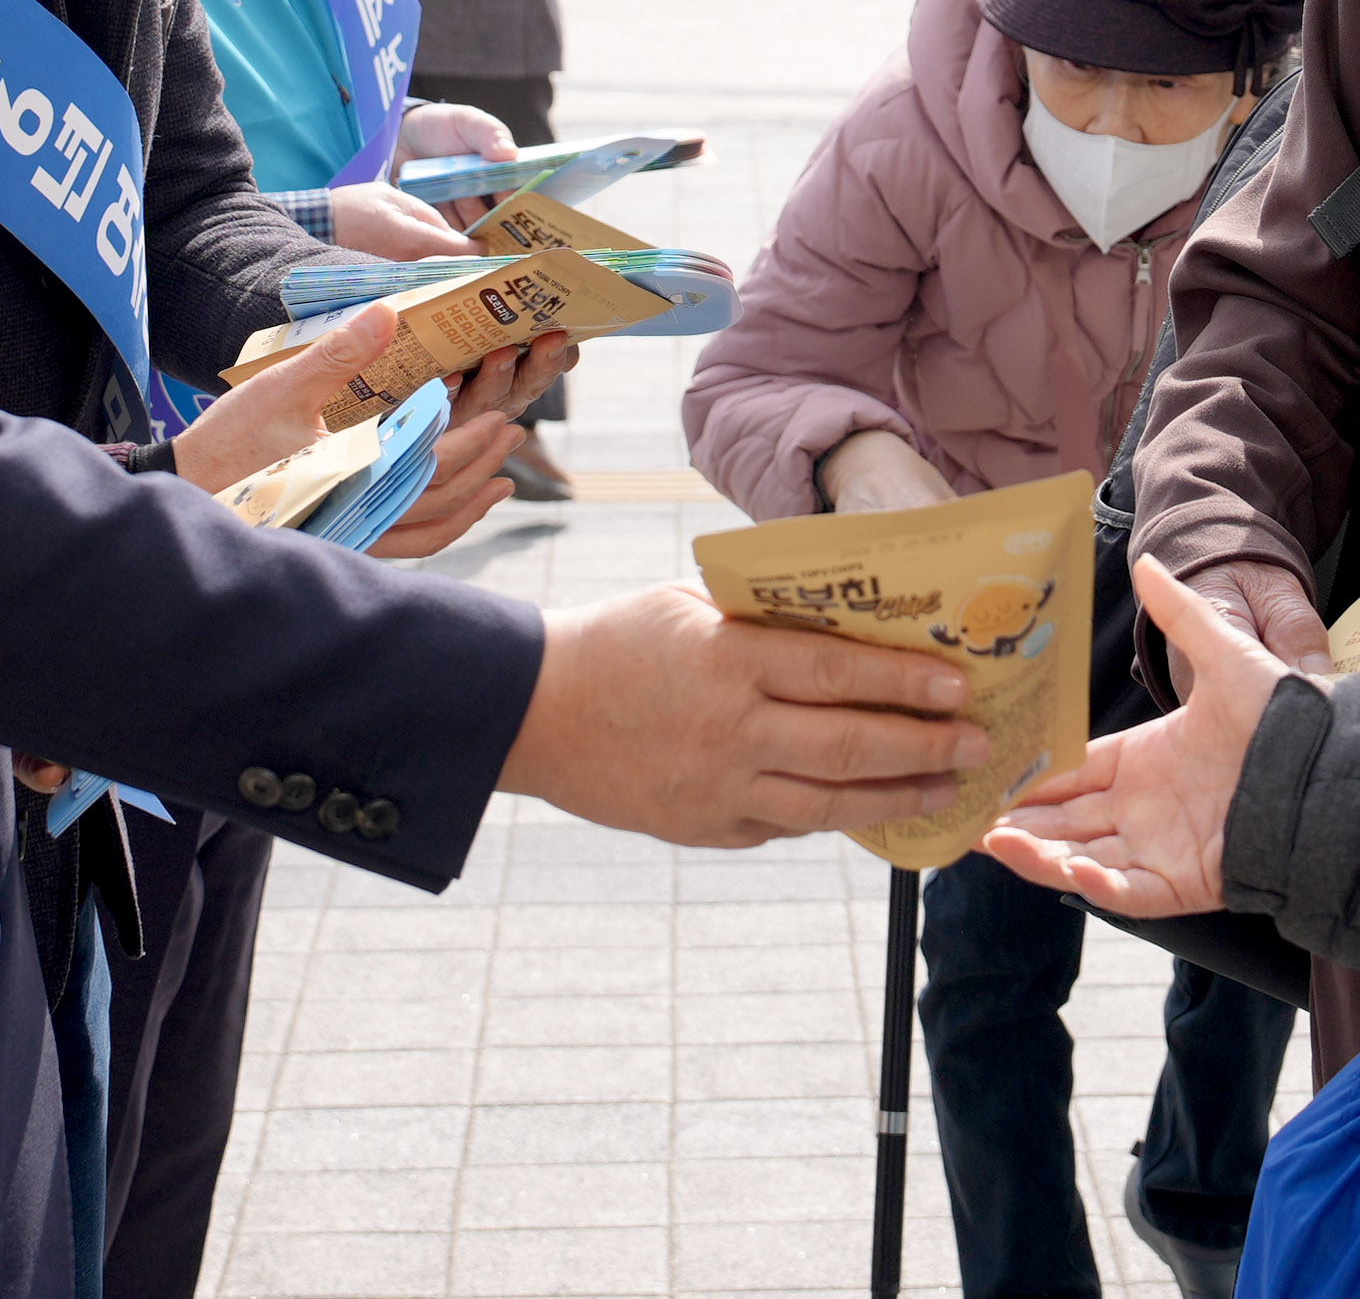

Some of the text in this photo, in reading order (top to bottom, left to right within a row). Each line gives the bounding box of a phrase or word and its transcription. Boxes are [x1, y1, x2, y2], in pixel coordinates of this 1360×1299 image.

[430, 310, 478, 355] BEAUTY
[446, 302, 498, 351] HEALTHY
[462, 296, 512, 343] COOKIA'S
